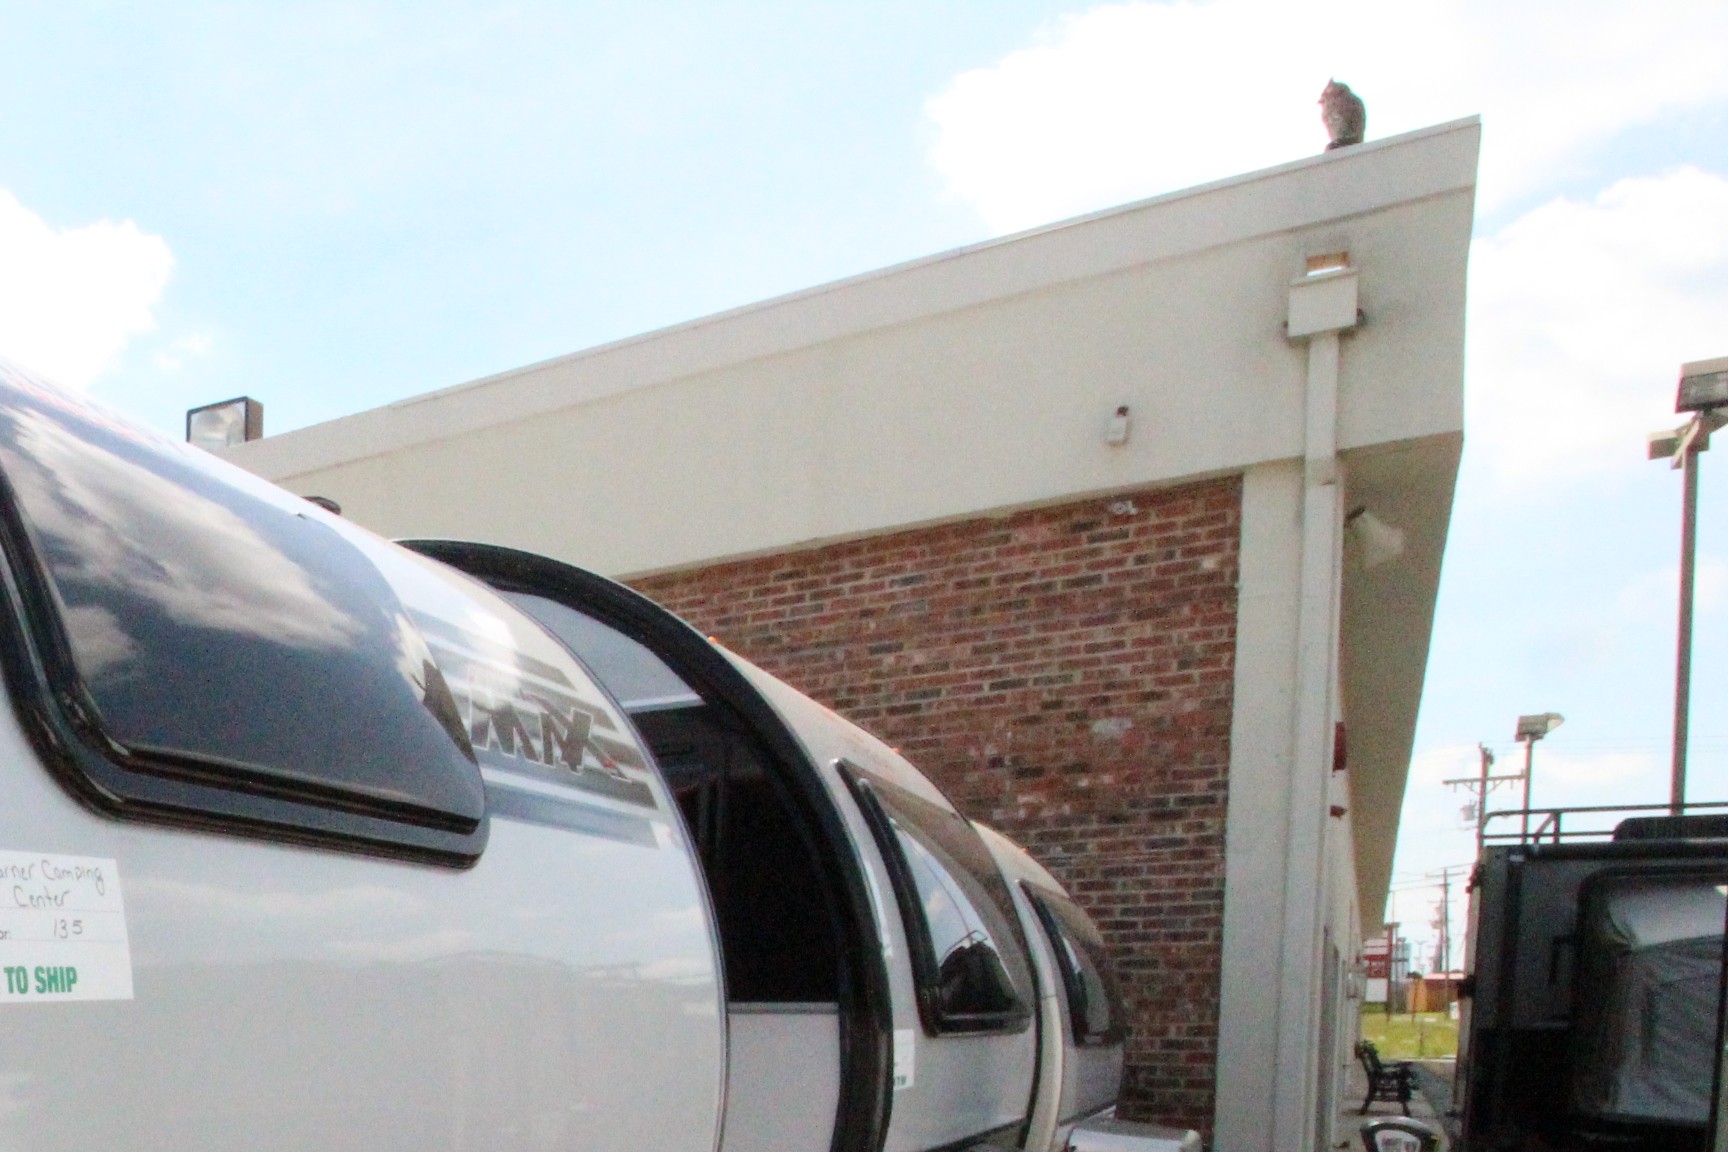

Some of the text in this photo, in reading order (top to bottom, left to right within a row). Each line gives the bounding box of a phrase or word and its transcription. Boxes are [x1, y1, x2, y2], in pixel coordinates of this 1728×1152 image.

[13, 885, 70, 908] Center
[53, 919, 83, 939] 135
[4, 966, 29, 994] TO
[34, 965, 78, 994] SHIP
